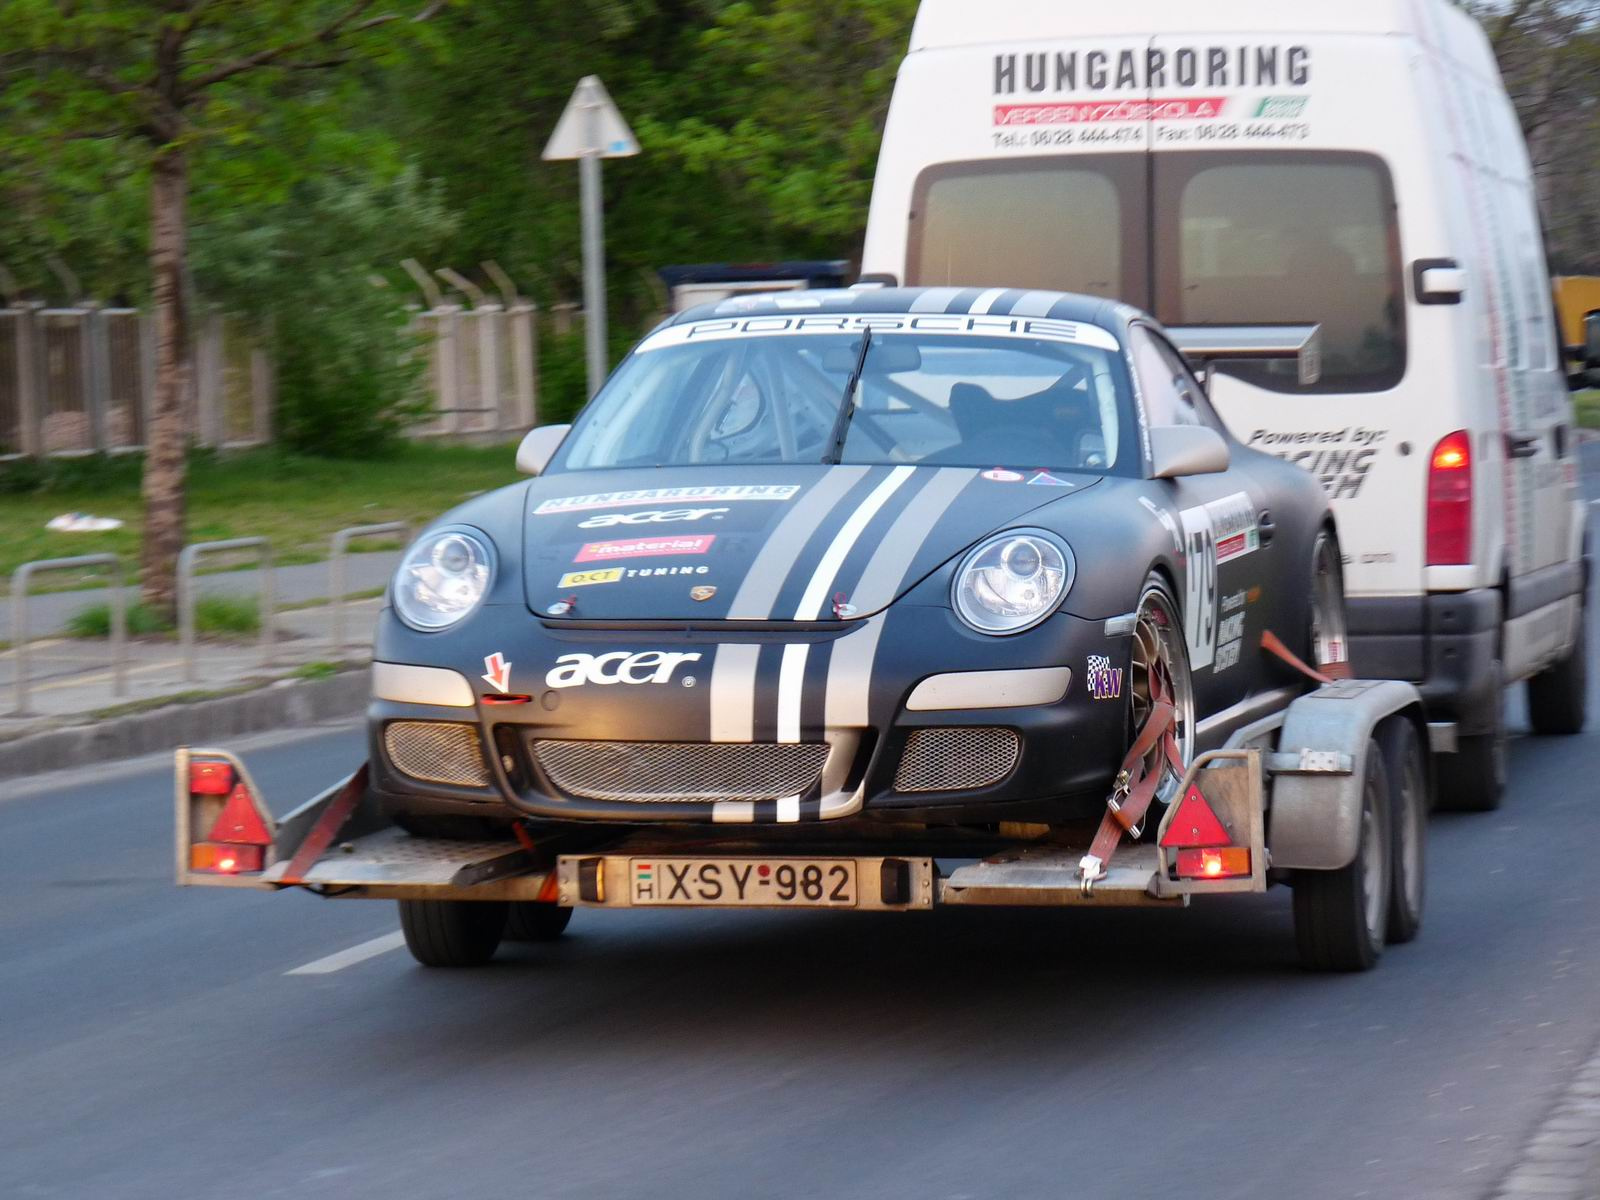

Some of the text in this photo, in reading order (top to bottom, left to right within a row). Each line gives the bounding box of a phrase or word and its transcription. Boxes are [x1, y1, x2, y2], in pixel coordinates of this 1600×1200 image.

[993, 46, 1309, 94] HUNGARORING
[687, 316, 1077, 339] PORSCHE
[1249, 427, 1349, 446] Powered
[577, 507, 729, 529] acer
[626, 566, 709, 577] TUNING
[545, 651, 702, 689] acer
[1094, 668, 1123, 700] KW
